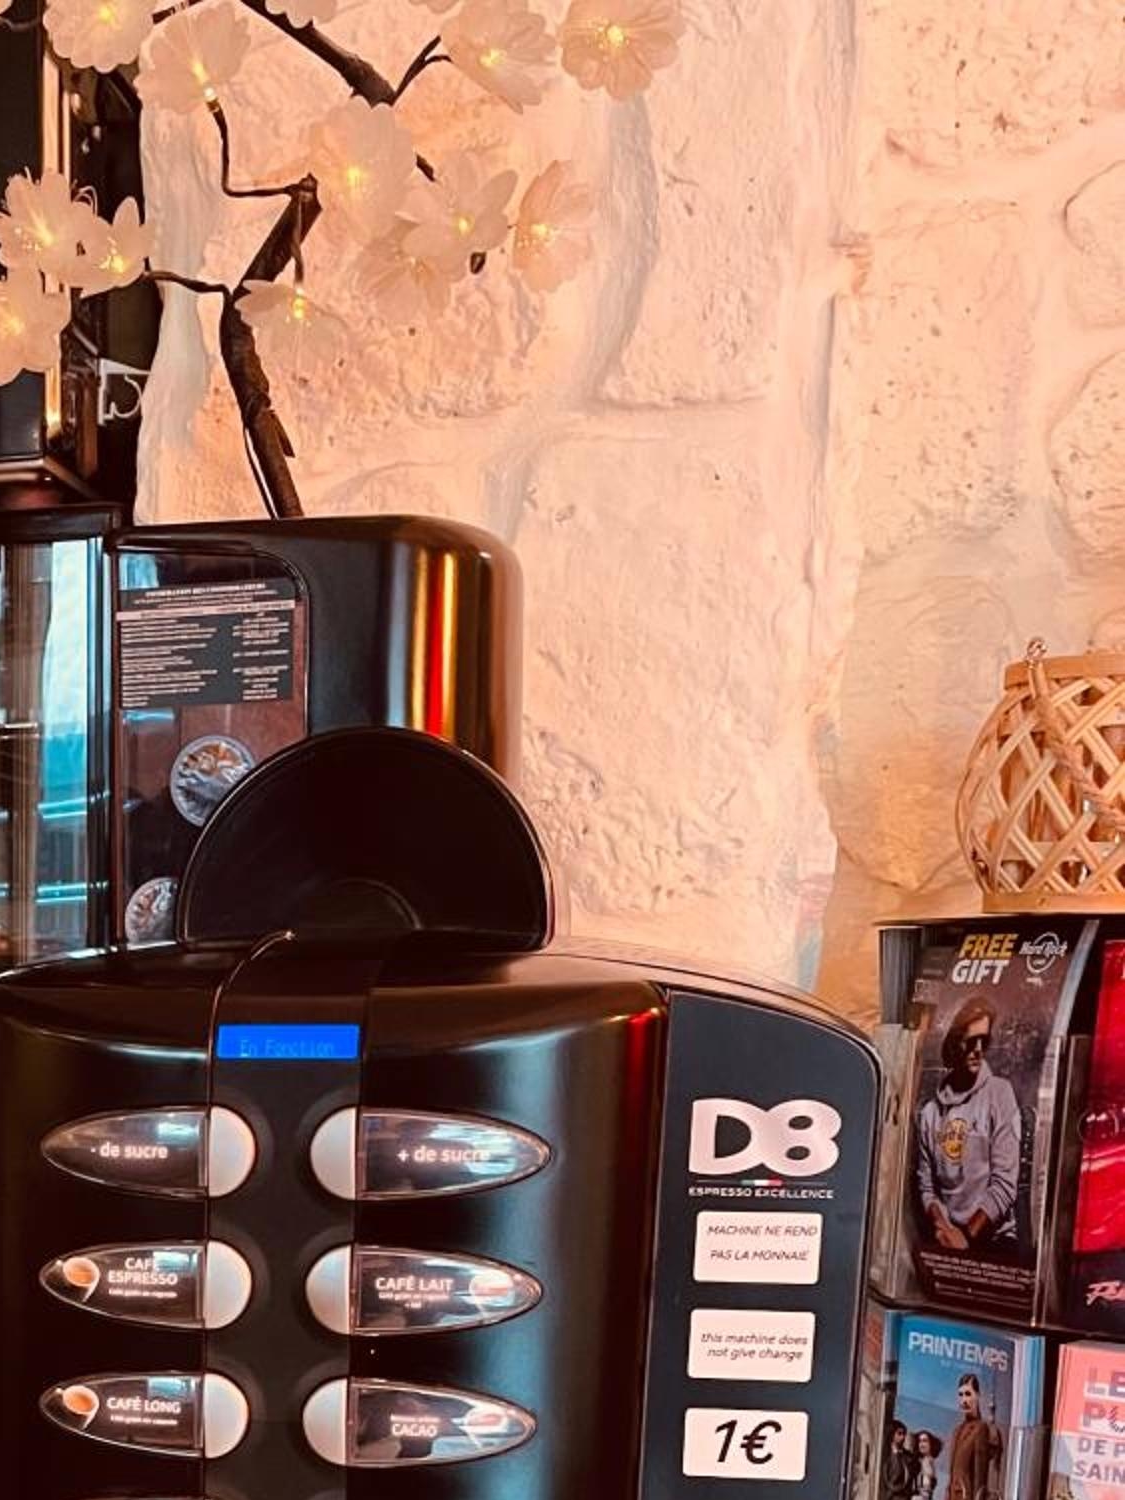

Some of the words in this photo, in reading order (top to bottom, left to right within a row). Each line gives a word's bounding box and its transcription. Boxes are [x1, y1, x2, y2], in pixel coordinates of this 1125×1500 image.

[958, 934, 1018, 958] FREE
[951, 959, 1009, 984] GIFT
[688, 1097, 842, 1177] D8
[100, 1142, 122, 1158] de
[124, 1145, 168, 1160] sucre
[415, 1146, 436, 1162] de
[440, 1149, 491, 1163] sucre
[689, 1187, 752, 1197] ESPRESSO
[755, 1188, 835, 1199] EXCELLENCE
[707, 1225, 762, 1236] MACHINE
[765, 1226, 782, 1236] NE
[784, 1226, 818, 1237] REND
[710, 1249, 732, 1260] PAS
[734, 1250, 750, 1261] LA
[751, 1250, 810, 1262] MONNAIE
[108, 1269, 178, 1286] ESPRESSO
[376, 1275, 415, 1291] CAFÉ
[419, 1278, 454, 1291] LAIT
[701, 1333, 722, 1343] this
[725, 1333, 776, 1345] machine
[778, 1335, 808, 1345] does
[707, 1348, 729, 1357] not
[731, 1349, 756, 1360] give
[759, 1349, 804, 1362] change
[908, 1331, 1008, 1371] PRINTEMPS
[106, 1396, 142, 1411] CAFÉ
[144, 1400, 182, 1414] LONG
[392, 1423, 438, 1437] CACAO
[715, 1419, 782, 1465] 1€
[1078, 1437, 1107, 1455] DE
